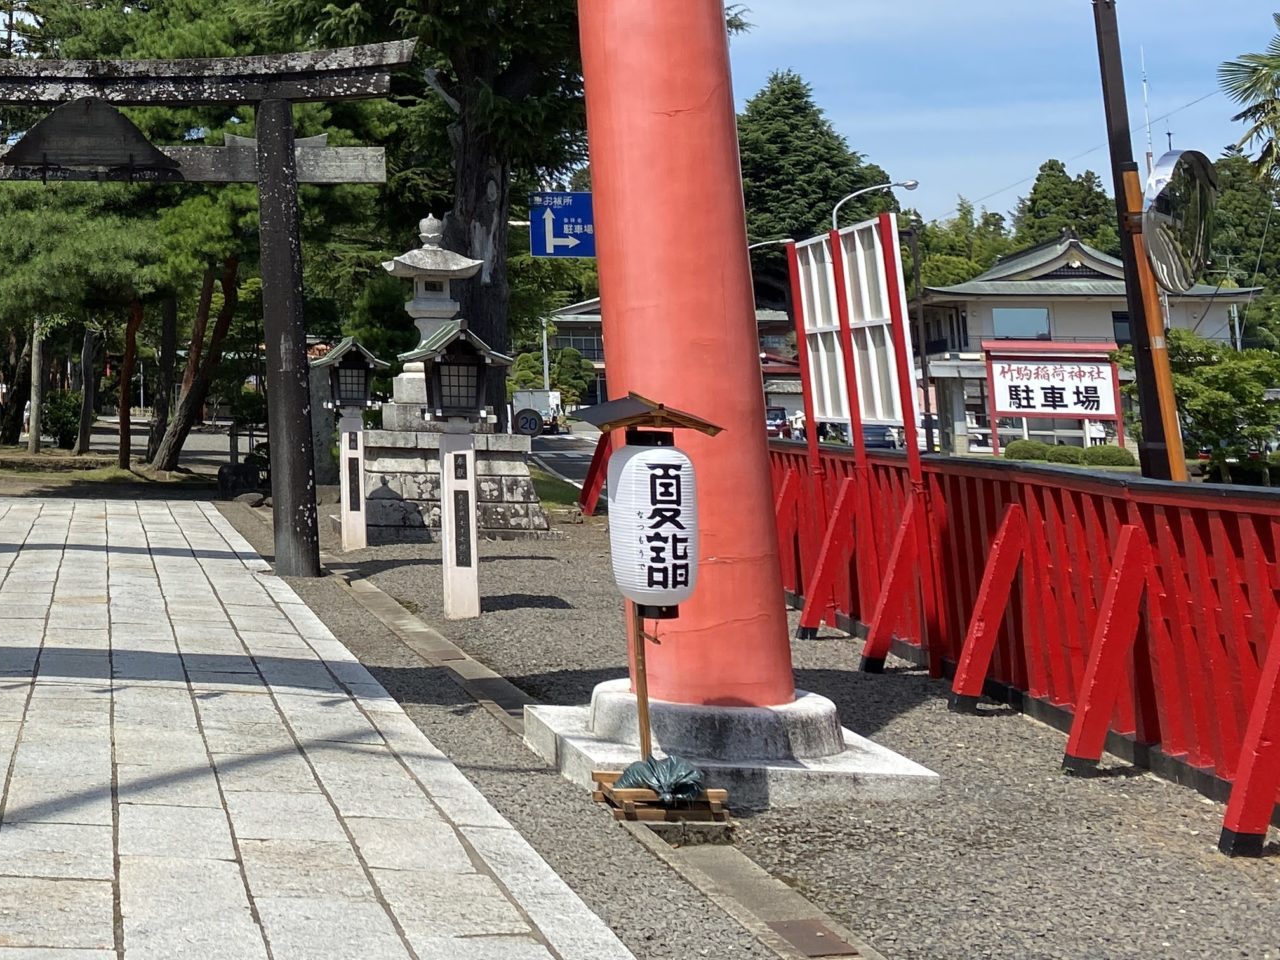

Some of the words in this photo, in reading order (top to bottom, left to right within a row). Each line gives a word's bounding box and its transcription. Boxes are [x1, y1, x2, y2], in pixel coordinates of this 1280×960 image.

[563, 224, 594, 234] 駐車場
[999, 363, 1106, 383] 竹駒稲荷神社
[1008, 384, 1100, 411] 駐車場
[520, 416, 538, 431] 20
[645, 462, 689, 589] 夏詣
[636, 510, 646, 571] なつもうで
